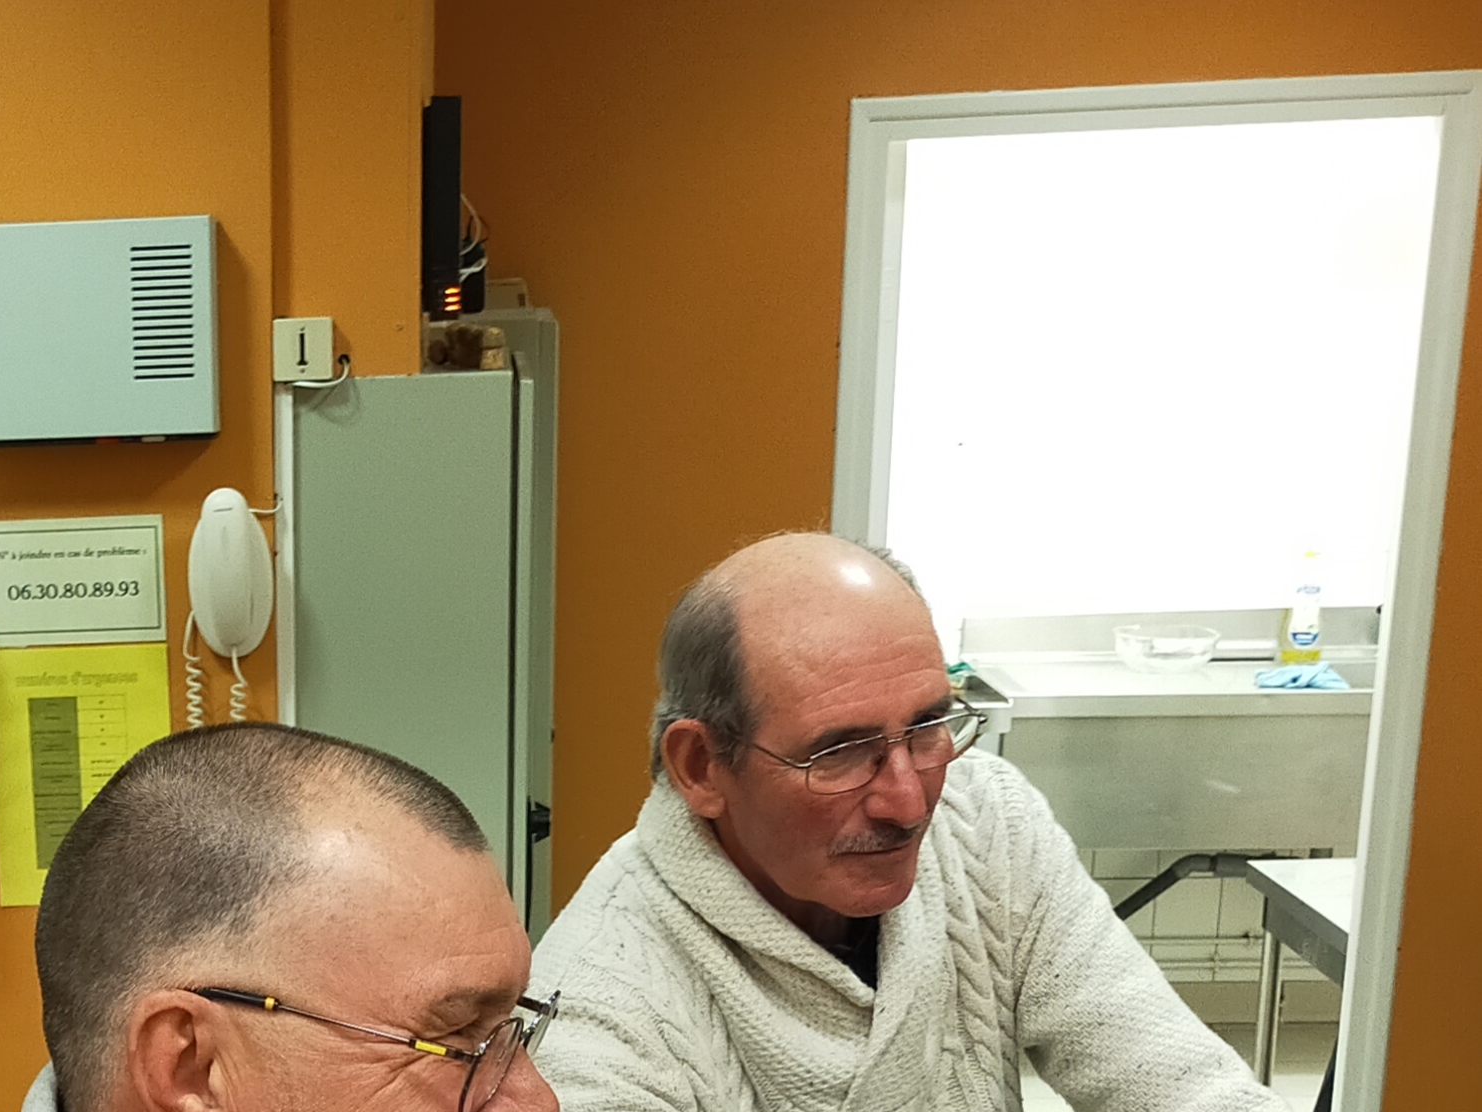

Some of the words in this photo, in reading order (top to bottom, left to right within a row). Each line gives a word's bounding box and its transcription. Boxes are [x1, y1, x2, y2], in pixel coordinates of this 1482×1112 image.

[18, 548, 51, 562] joindre
[54, 551, 65, 559] en
[83, 547, 95, 558] de
[7, 580, 140, 602] 06.30.80.89.93
